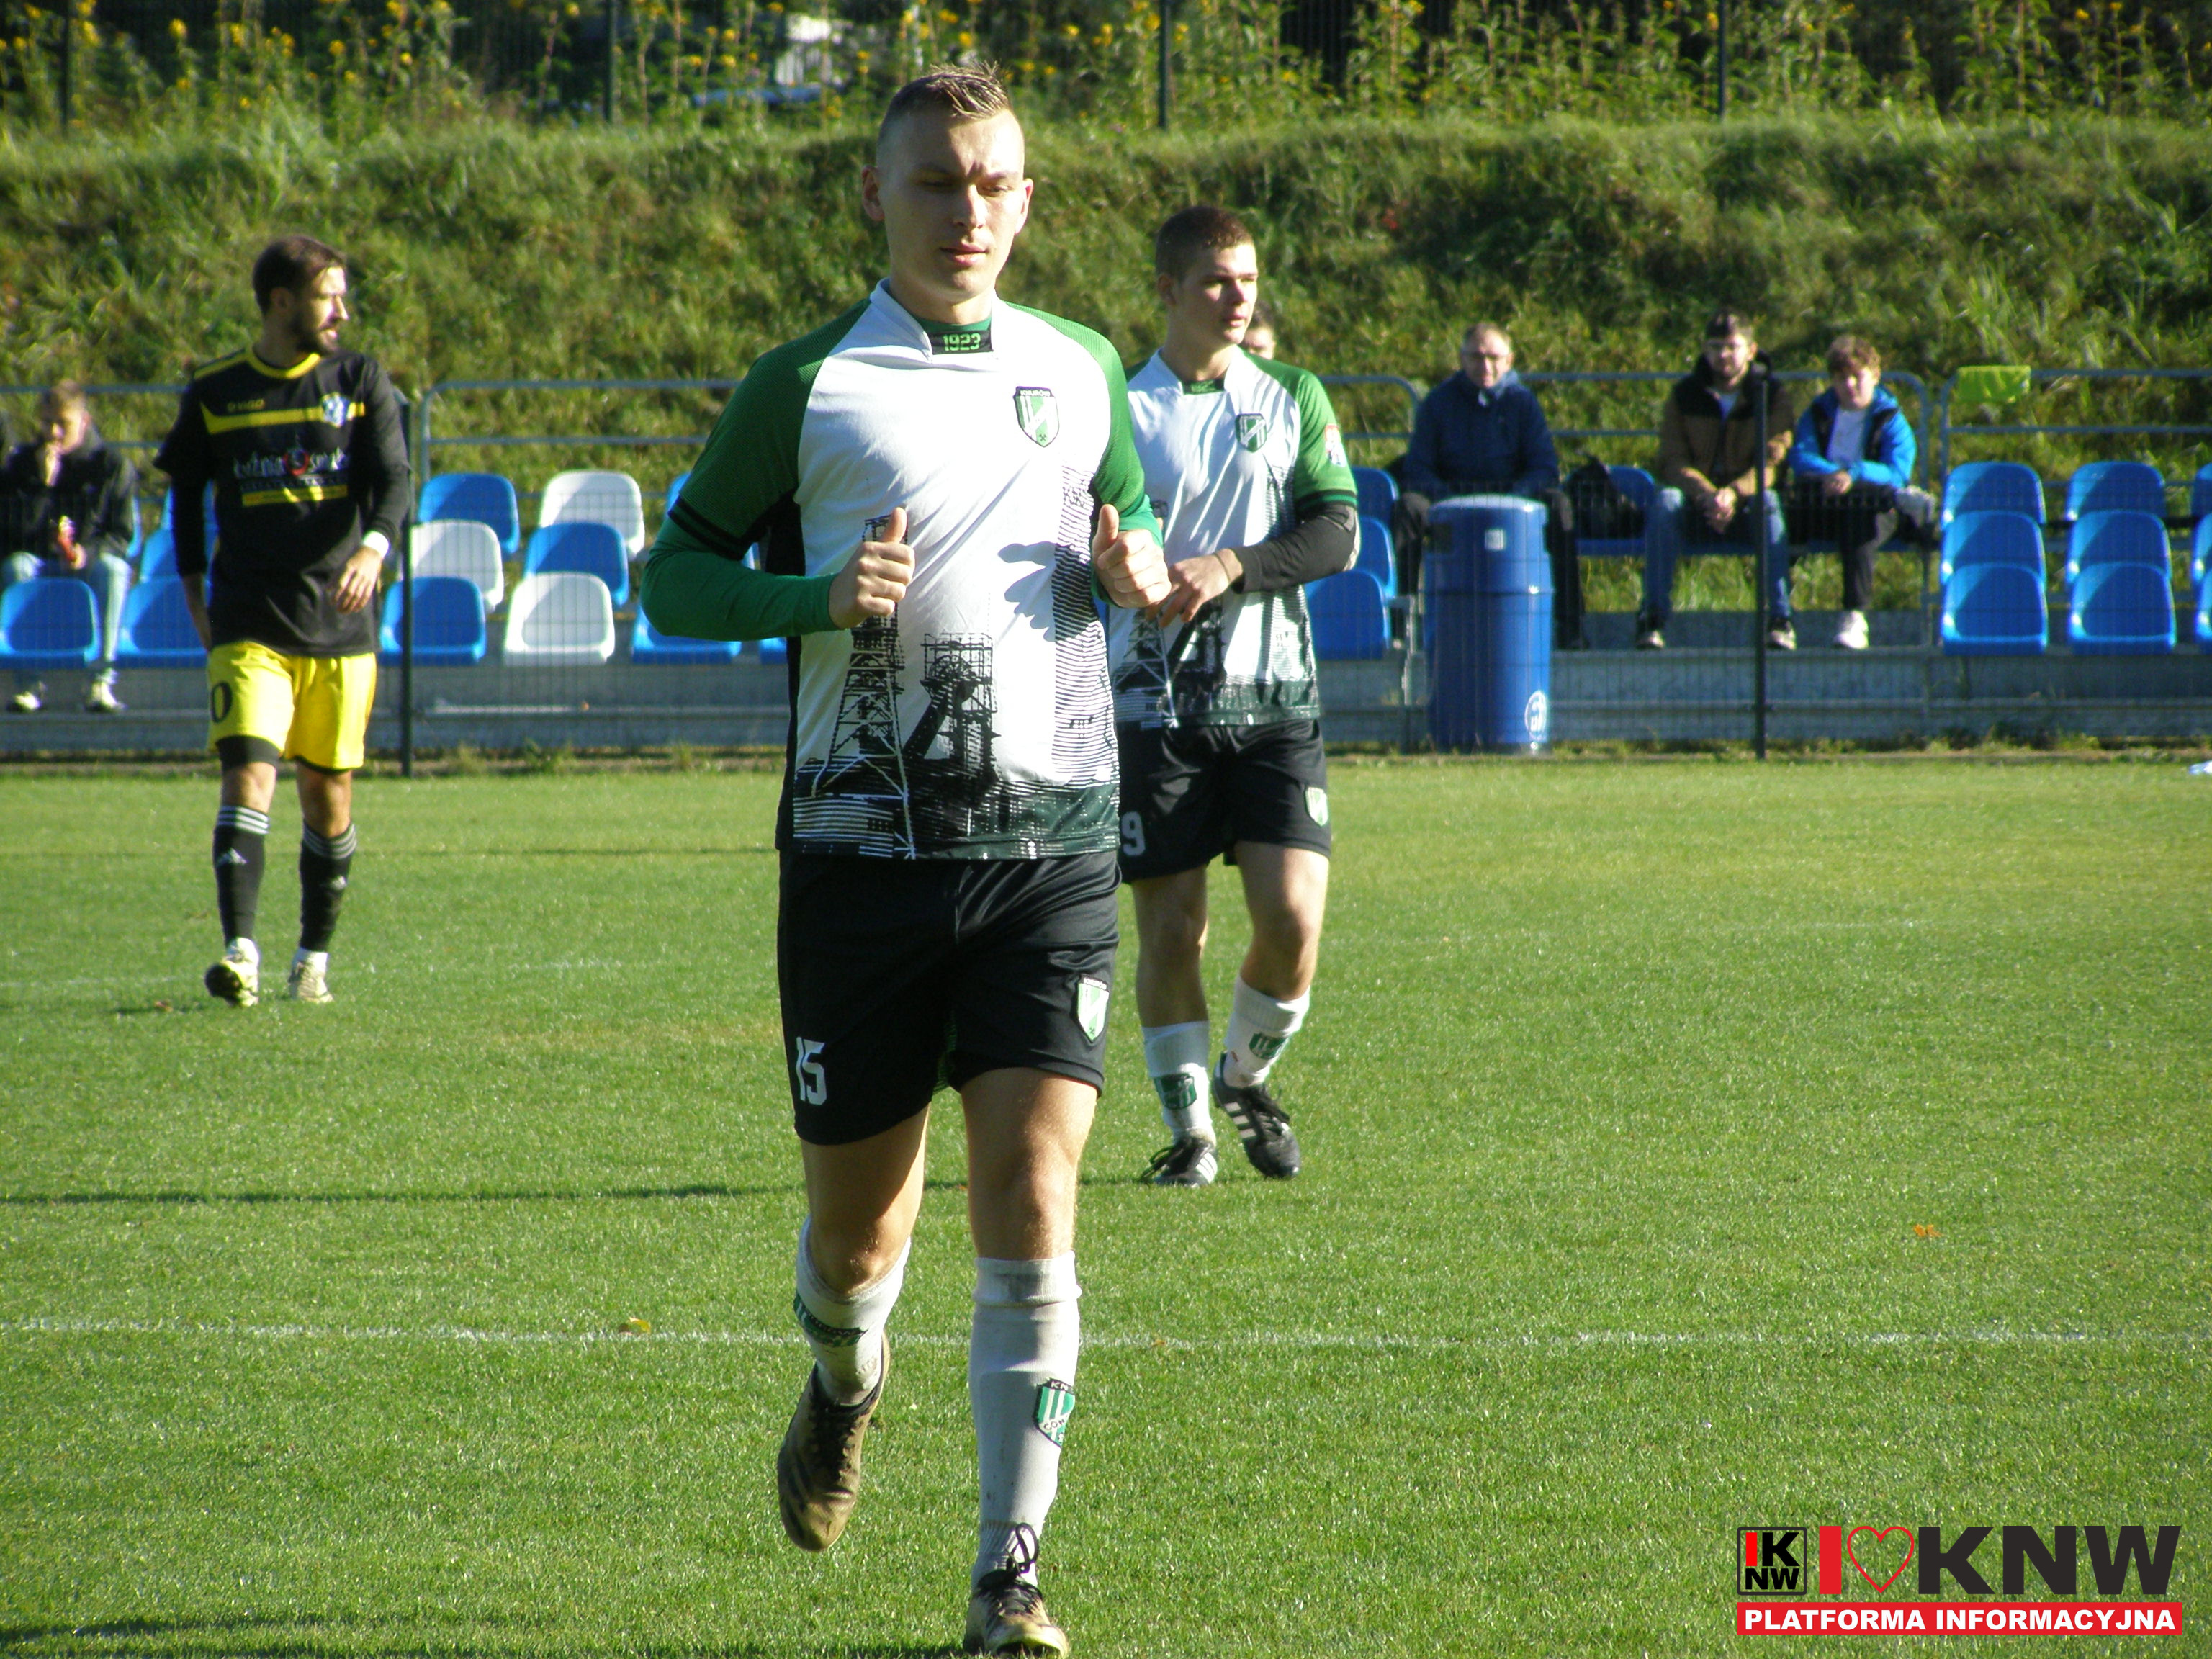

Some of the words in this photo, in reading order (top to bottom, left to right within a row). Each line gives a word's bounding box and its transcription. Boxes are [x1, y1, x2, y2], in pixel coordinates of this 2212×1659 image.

[943, 333, 981, 351] 1923
[1121, 811, 1146, 856] 9
[796, 1036, 827, 1106] 15
